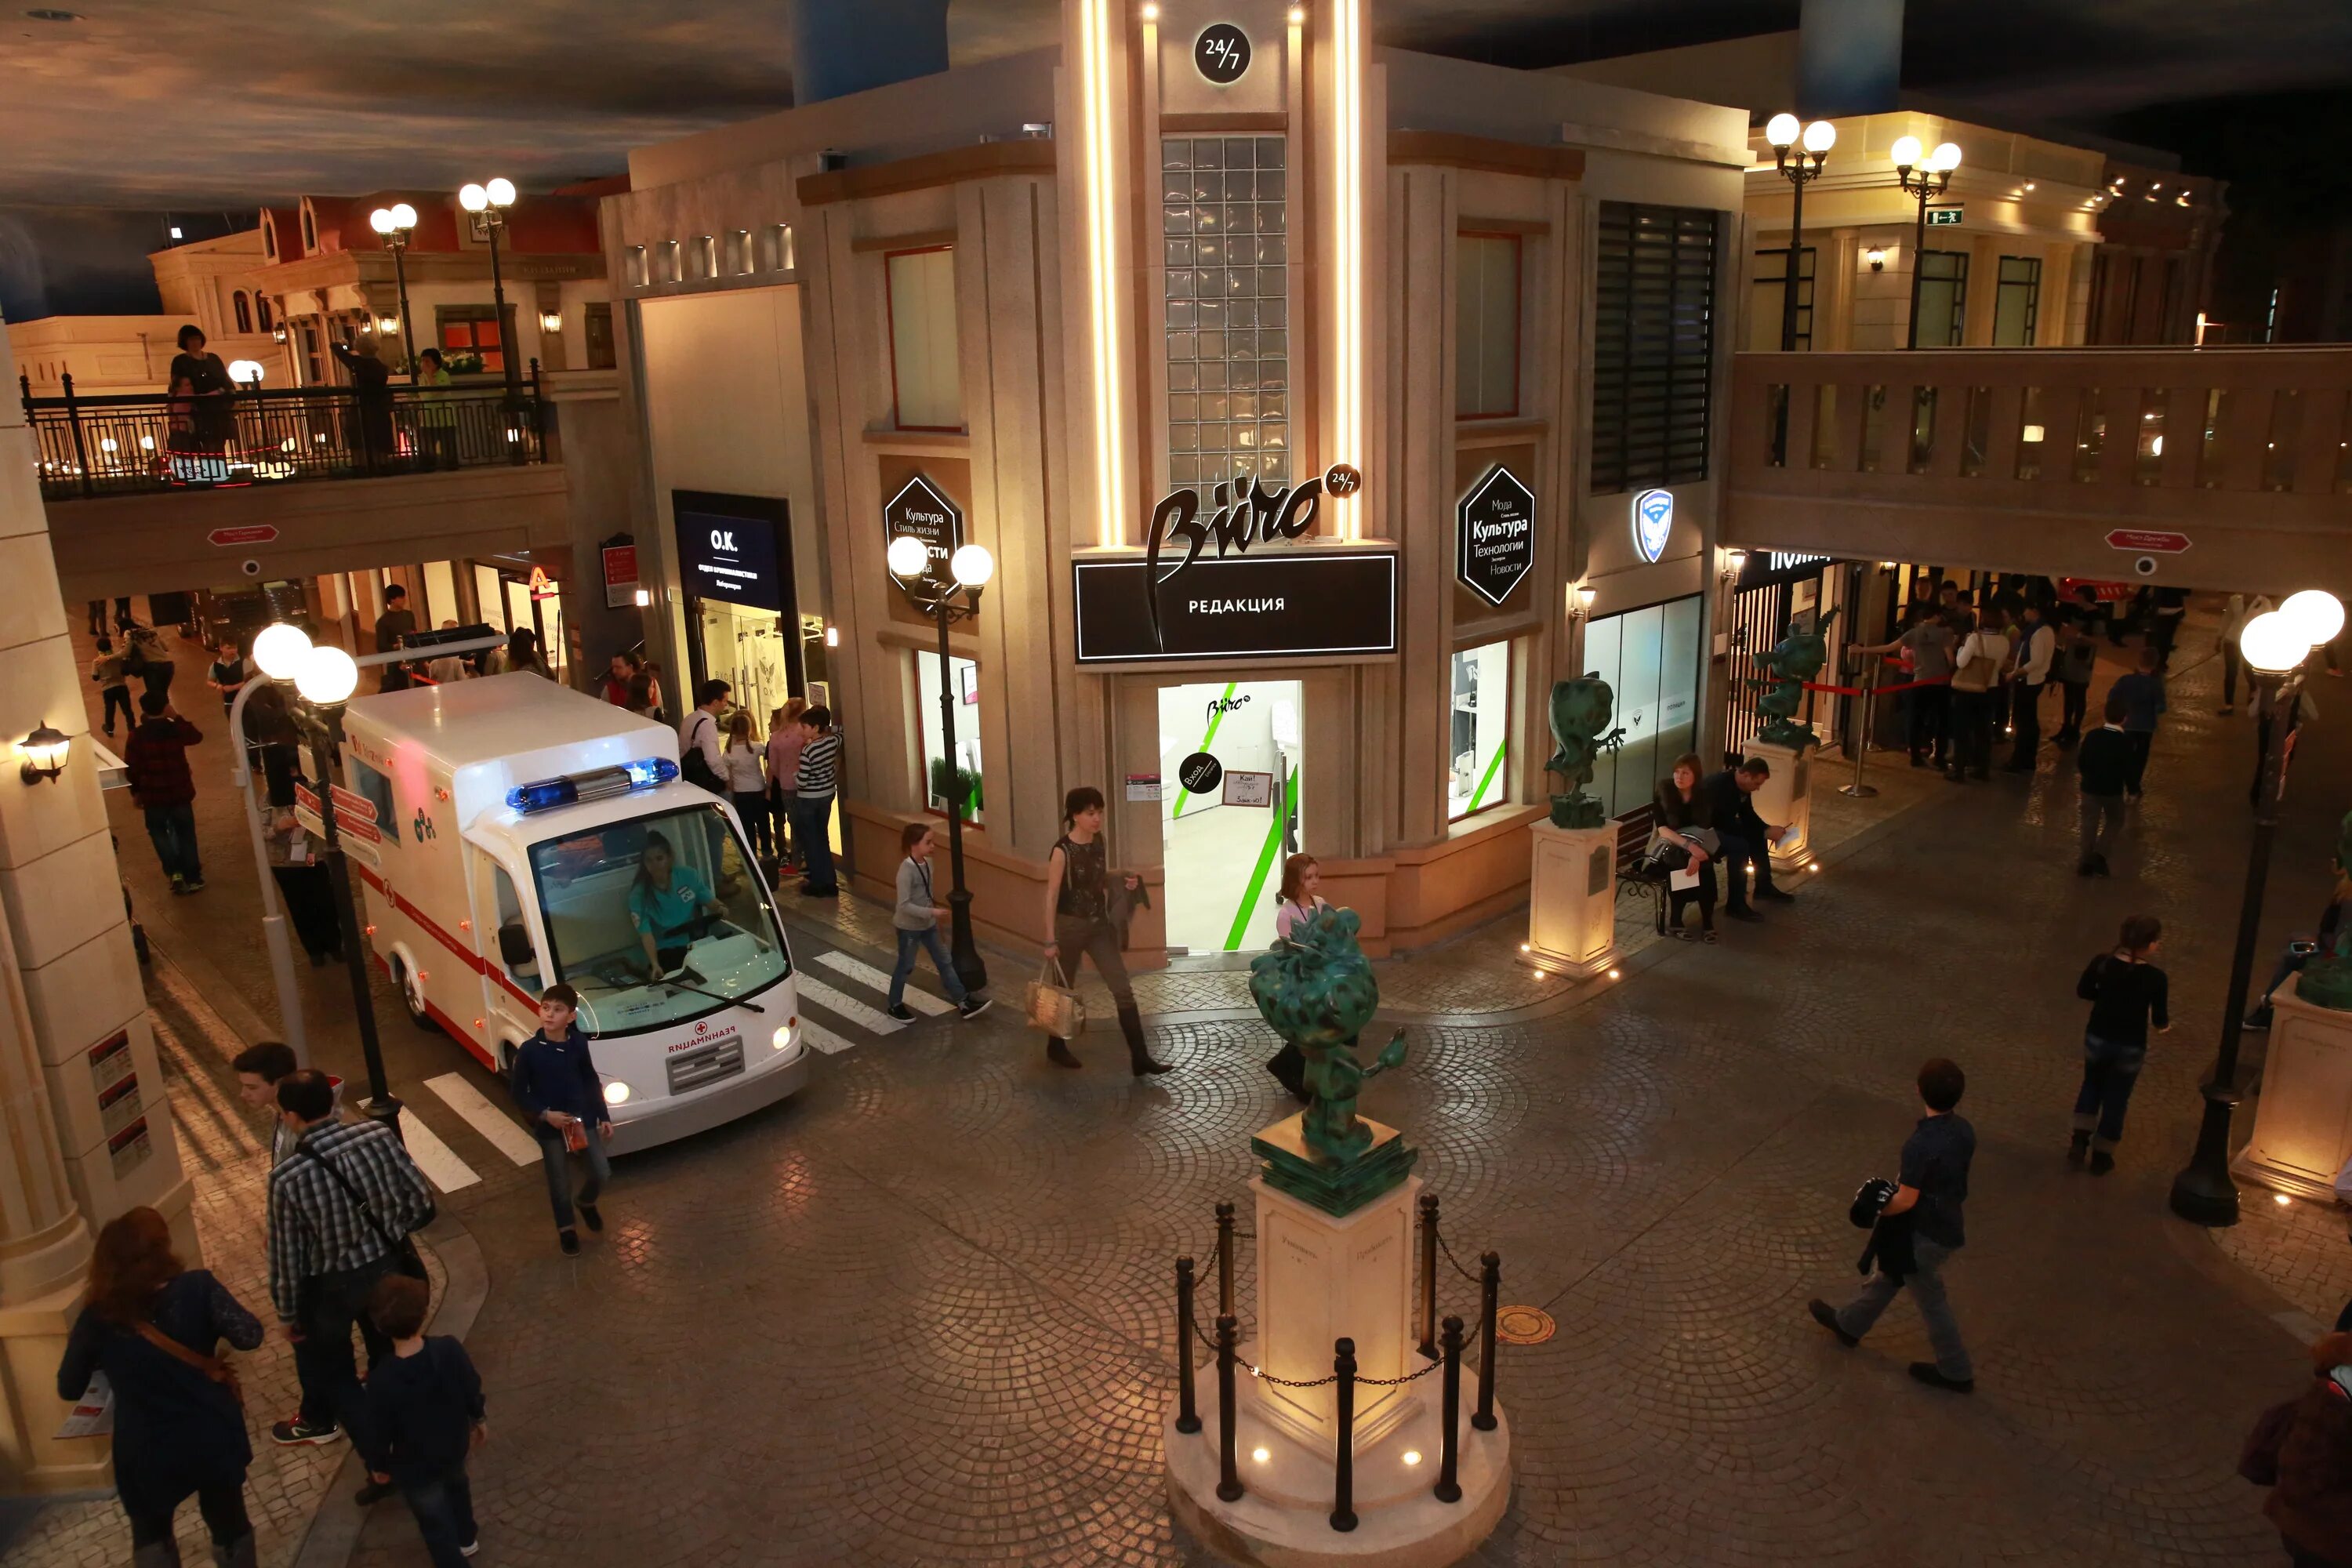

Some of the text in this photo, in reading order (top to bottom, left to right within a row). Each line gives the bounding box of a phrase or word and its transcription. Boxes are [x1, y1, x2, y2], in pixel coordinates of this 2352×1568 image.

[1205, 38, 1240, 69] 24/7
[1492, 499, 1512, 510] Мода
[906, 507, 944, 526] Культура
[894, 521, 940, 536] Стиль жизни
[1473, 518, 1528, 543] Культура
[1473, 540, 1524, 558] Технологии
[1146, 472, 1355, 652] Büro 24/7
[1490, 562, 1522, 576] Новости
[1189, 597, 1285, 615] РЕДАКЦИЯ
[1207, 697, 1243, 731] Büro
[1184, 764, 1204, 786] Вход
